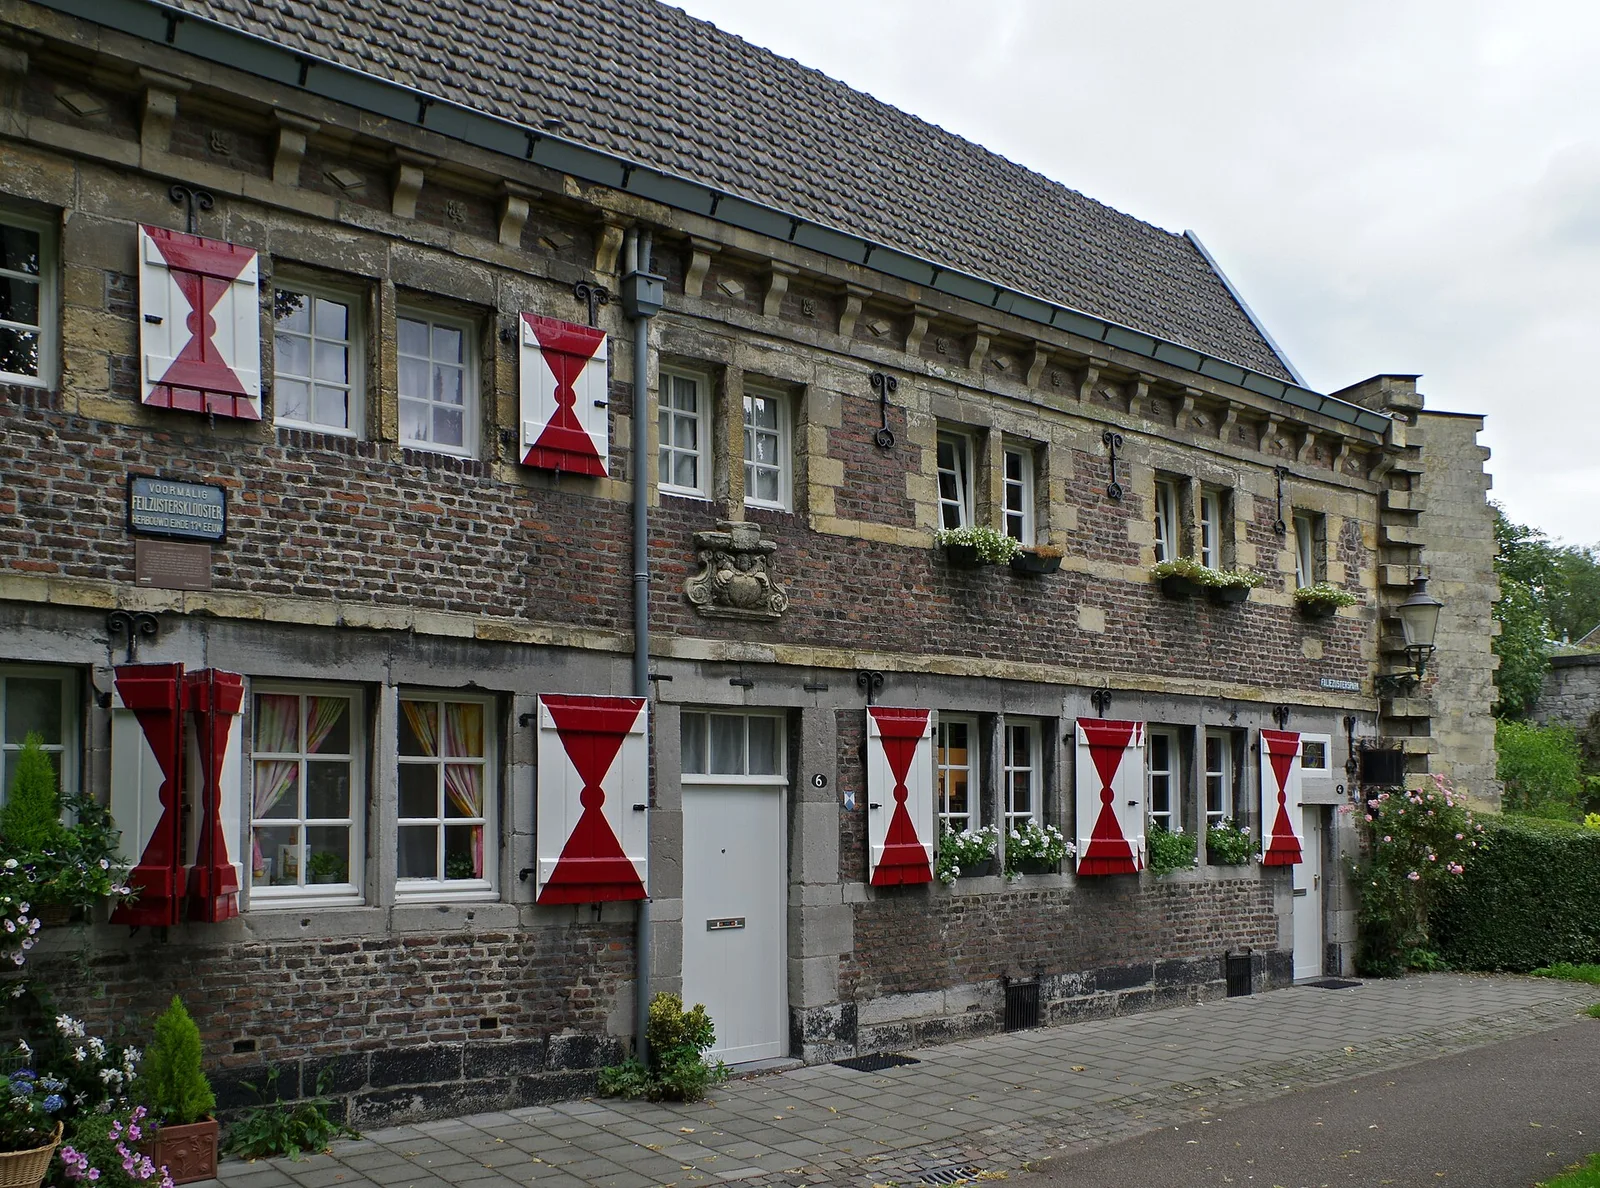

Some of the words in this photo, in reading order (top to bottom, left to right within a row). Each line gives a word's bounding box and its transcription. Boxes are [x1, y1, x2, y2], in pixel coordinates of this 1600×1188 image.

[149, 483, 208, 499] VOORMALIG
[132, 514, 169, 528] HERBOUWD
[170, 518, 189, 530] EINDE
[203, 522, 223, 533] EEUW
[815, 774, 823, 787] 6
